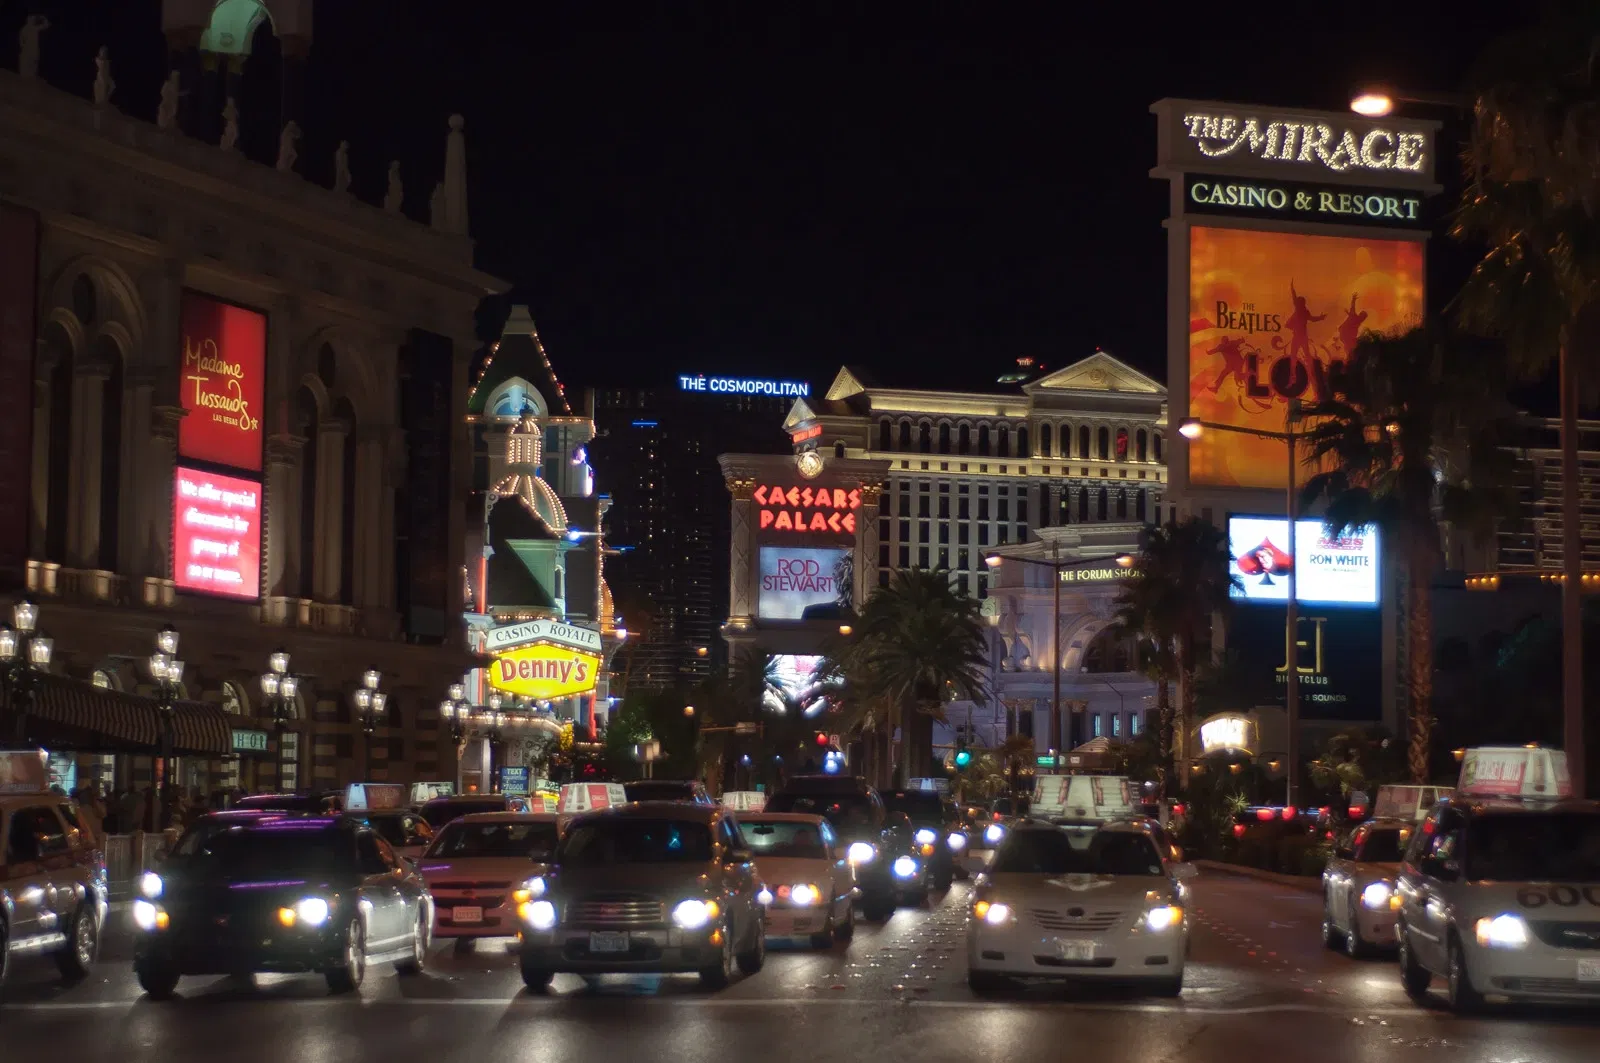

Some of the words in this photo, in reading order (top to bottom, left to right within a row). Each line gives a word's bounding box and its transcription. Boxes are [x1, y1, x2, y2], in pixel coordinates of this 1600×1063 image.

[1184, 115, 1236, 141] THE
[1199, 118, 1425, 172] MIRAGE
[1190, 182, 1287, 209] CASINO
[1293, 191, 1312, 211] &
[1317, 191, 1420, 219] RESORT
[1242, 301, 1256, 311] THE
[184, 335, 244, 379] Madame
[680, 376, 707, 392] THE
[709, 379, 809, 397] COSMOPOLITAN
[186, 375, 250, 431] Tussauds
[213, 413, 223, 423] LAS
[753, 484, 861, 510] CAESARS
[759, 509, 857, 534] PALACE
[777, 557, 820, 577] ROD
[1309, 554, 1332, 565] RON
[1335, 554, 1369, 567] WHITE
[762, 574, 834, 593] STEWART
[1076, 568, 1113, 581] FORUM
[496, 623, 541, 642] CASINO
[549, 623, 595, 645] ROYALE
[500, 656, 588, 684] Denny's
[507, 767, 523, 776] TEXT
